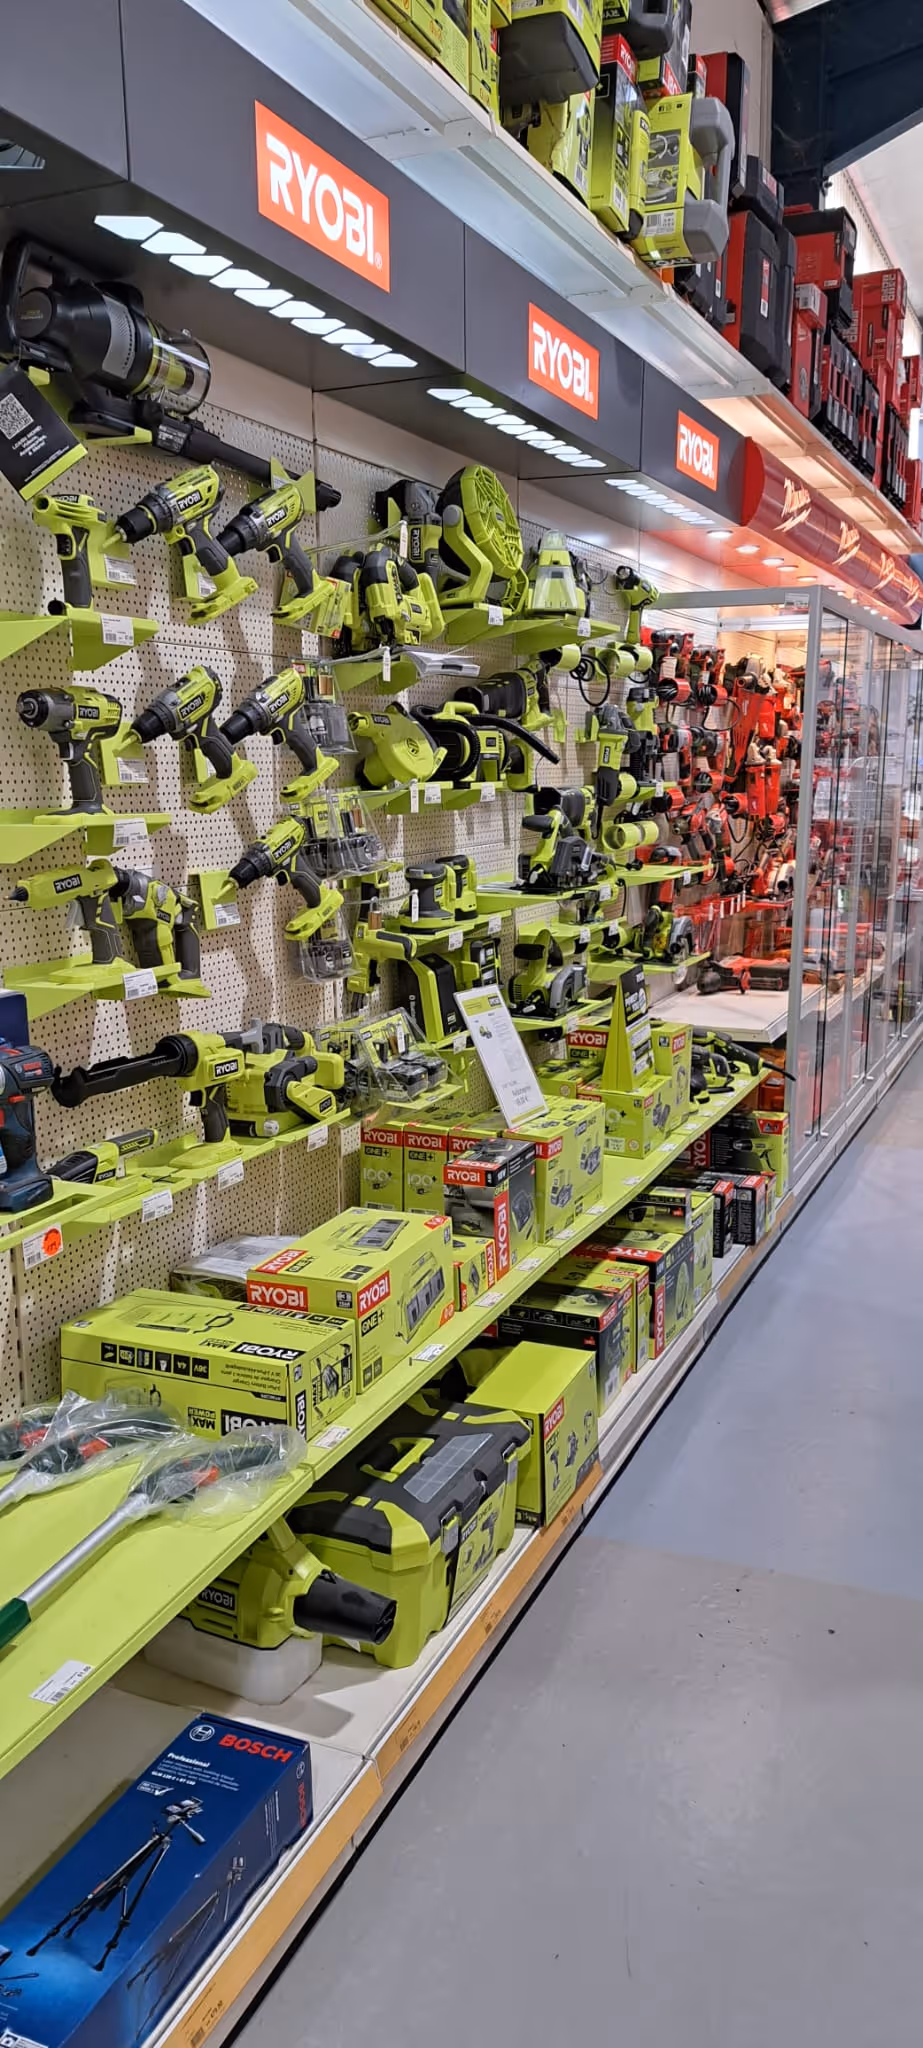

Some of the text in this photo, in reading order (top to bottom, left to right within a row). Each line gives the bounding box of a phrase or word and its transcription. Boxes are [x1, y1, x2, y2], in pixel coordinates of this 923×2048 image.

[266, 132, 374, 265] RYOBI
[532, 320, 590, 402] RYOBI
[679, 423, 714, 479] RYOBI
[178, 491, 201, 512] RYOBI
[267, 509, 287, 527] RYOBI
[412, 528, 420, 559] RYOBI
[79, 707, 99, 719] RYOBI
[181, 697, 203, 716] RYOBI
[270, 695, 288, 713] RYOBI
[275, 839, 292, 858] RYOBI
[54, 876, 81, 892] RYOBI
[569, 1032, 606, 1045] RYOBI
[215, 1060, 238, 1076] RYOBI
[364, 1130, 398, 1145] RYOBI
[407, 1134, 442, 1149] RYOBI
[452, 1138, 476, 1151] RYO
[447, 1169, 480, 1183] RYOBI
[497, 1202, 508, 1269] RYOBI
[262, 1250, 303, 1272] RYOBI
[487, 1246, 495, 1287] RYOBI
[250, 1284, 305, 1308] RYOBI
[359, 1276, 389, 1314] RYOBI
[237, 1343, 300, 1361] RYOBI
[176, 1361, 187, 1370] 4A
[193, 1364, 207, 1374] 36V
[192, 1416, 216, 1431] MAX
[544, 1402, 564, 1435] RYOBI
[202, 1589, 233, 1609] RYOBI
[218, 1733, 293, 1764] BOSCH
[167, 1752, 211, 1768] Professional
